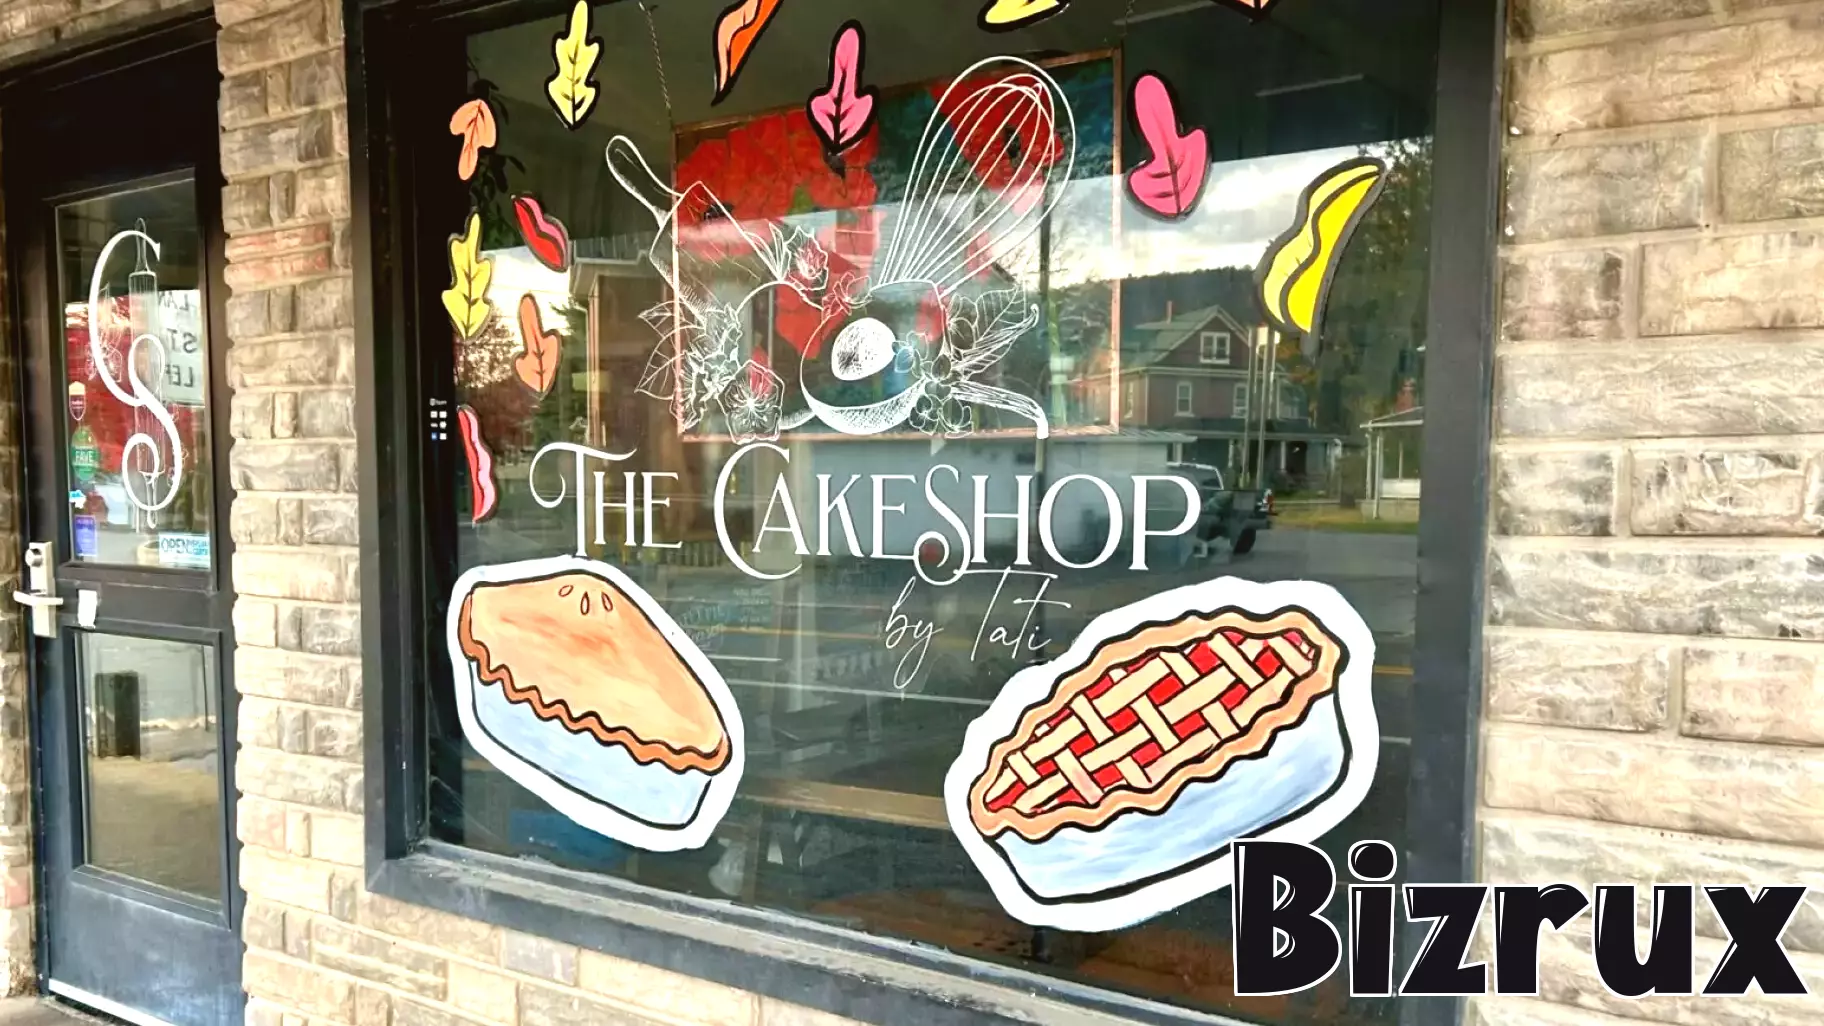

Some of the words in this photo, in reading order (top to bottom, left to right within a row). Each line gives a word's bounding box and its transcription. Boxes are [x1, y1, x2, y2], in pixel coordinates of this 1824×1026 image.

[529, 441, 683, 557] THE
[713, 442, 1201, 585] CAKESHOP
[885, 575, 944, 690] by
[952, 565, 1072, 662] Tati
